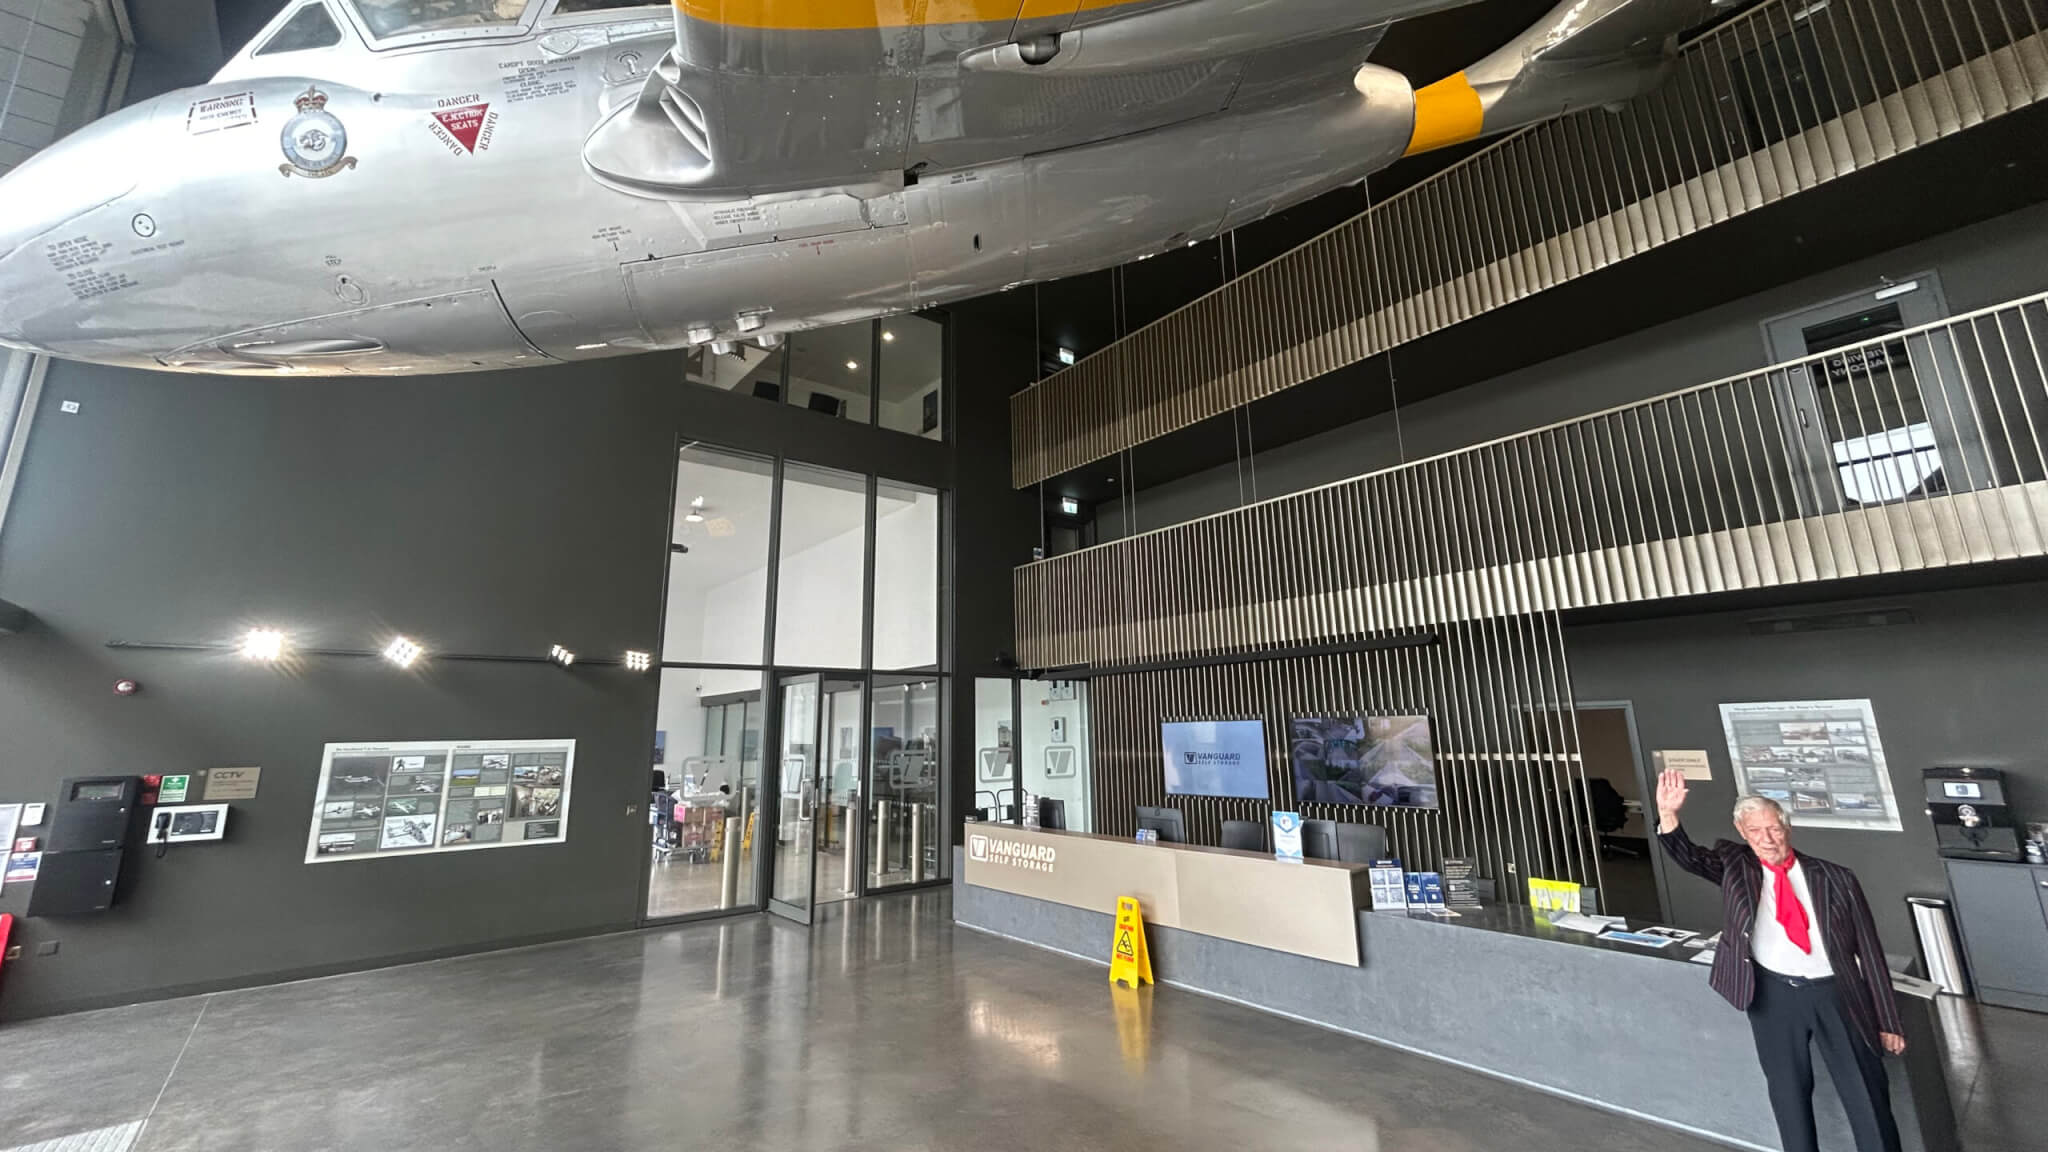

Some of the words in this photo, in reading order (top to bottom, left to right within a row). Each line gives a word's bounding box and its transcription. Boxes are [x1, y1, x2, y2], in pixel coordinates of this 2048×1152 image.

[200, 98, 243, 113] WARNING
[437, 93, 481, 108] DANGER
[450, 119, 479, 132] SEATS
[479, 111, 499, 151] DANGER
[428, 121, 464, 157] DANGER
[1197, 751, 1241, 761] VANGUARD
[214, 771, 246, 780] CCTV
[989, 838, 1056, 863] VANGUARD
[989, 853, 1010, 865] SELF
[1012, 856, 1055, 873] STORAGE
